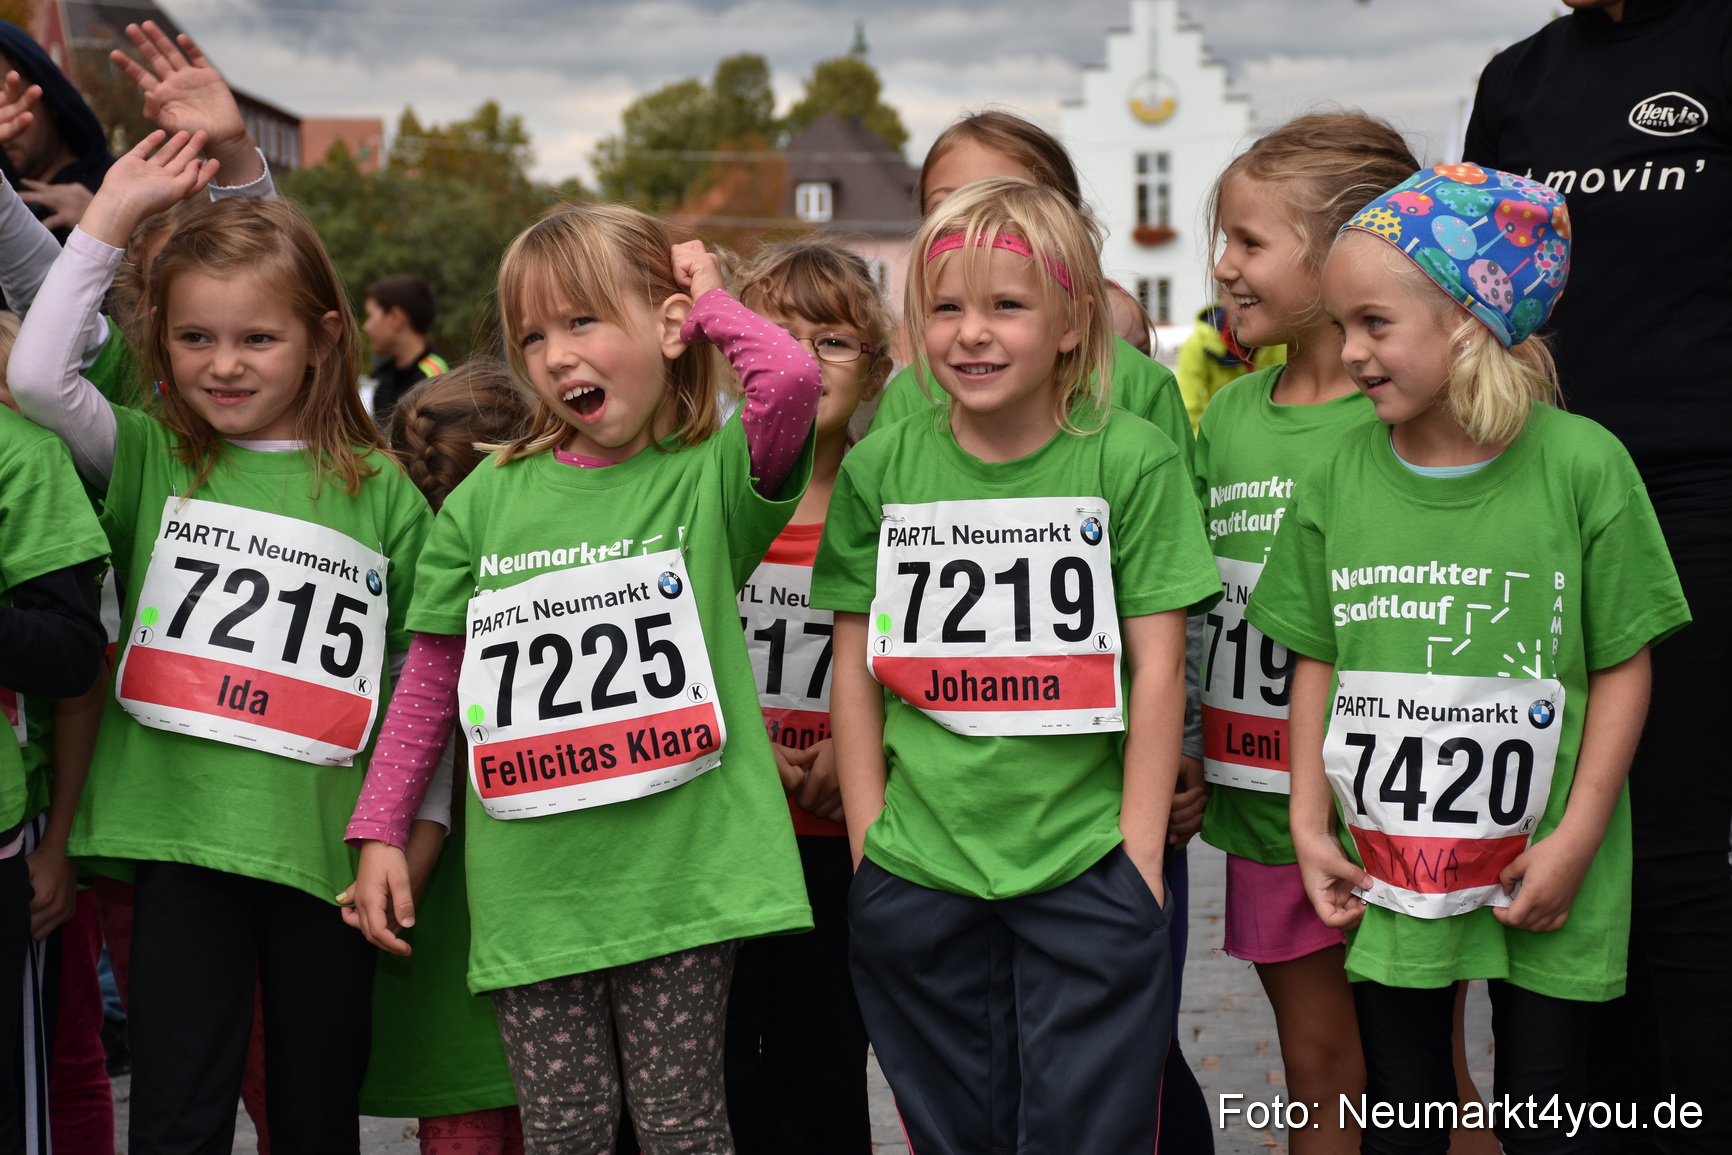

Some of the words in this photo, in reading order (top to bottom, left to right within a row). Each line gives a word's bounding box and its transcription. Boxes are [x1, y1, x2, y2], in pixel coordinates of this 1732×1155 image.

[1636, 103, 1700, 127] Hervis
[1637, 119, 1668, 128] SPORTS
[887, 525, 946, 547] PARTL
[952, 522, 1072, 545] Neumarkt
[163, 520, 241, 552] PARTL
[247, 534, 360, 584] Neumarkt
[479, 538, 634, 578] Neumarkter
[1331, 560, 1493, 592] Neumarkter
[471, 604, 529, 640] PARTL
[532, 581, 651, 621] Neumarkt
[897, 555, 1096, 644] 7219
[165, 556, 369, 680] 7215
[140, 629, 148, 643] 1
[880, 639, 886, 653] 1
[1098, 635, 1107, 650] K
[357, 679, 367, 693] K
[479, 611, 687, 729] 7225
[924, 668, 1061, 703] Johanna
[216, 675, 270, 716] Ida
[690, 685, 703, 701] K
[1335, 695, 1391, 719] PARTL
[1397, 698, 1519, 725] Neumarkt
[475, 727, 484, 742] 1
[1226, 722, 1281, 761] Leni
[480, 743, 618, 790] Felicitas
[625, 722, 714, 765] Klara
[1344, 732, 1535, 826] 7420
[1521, 817, 1534, 832] K
